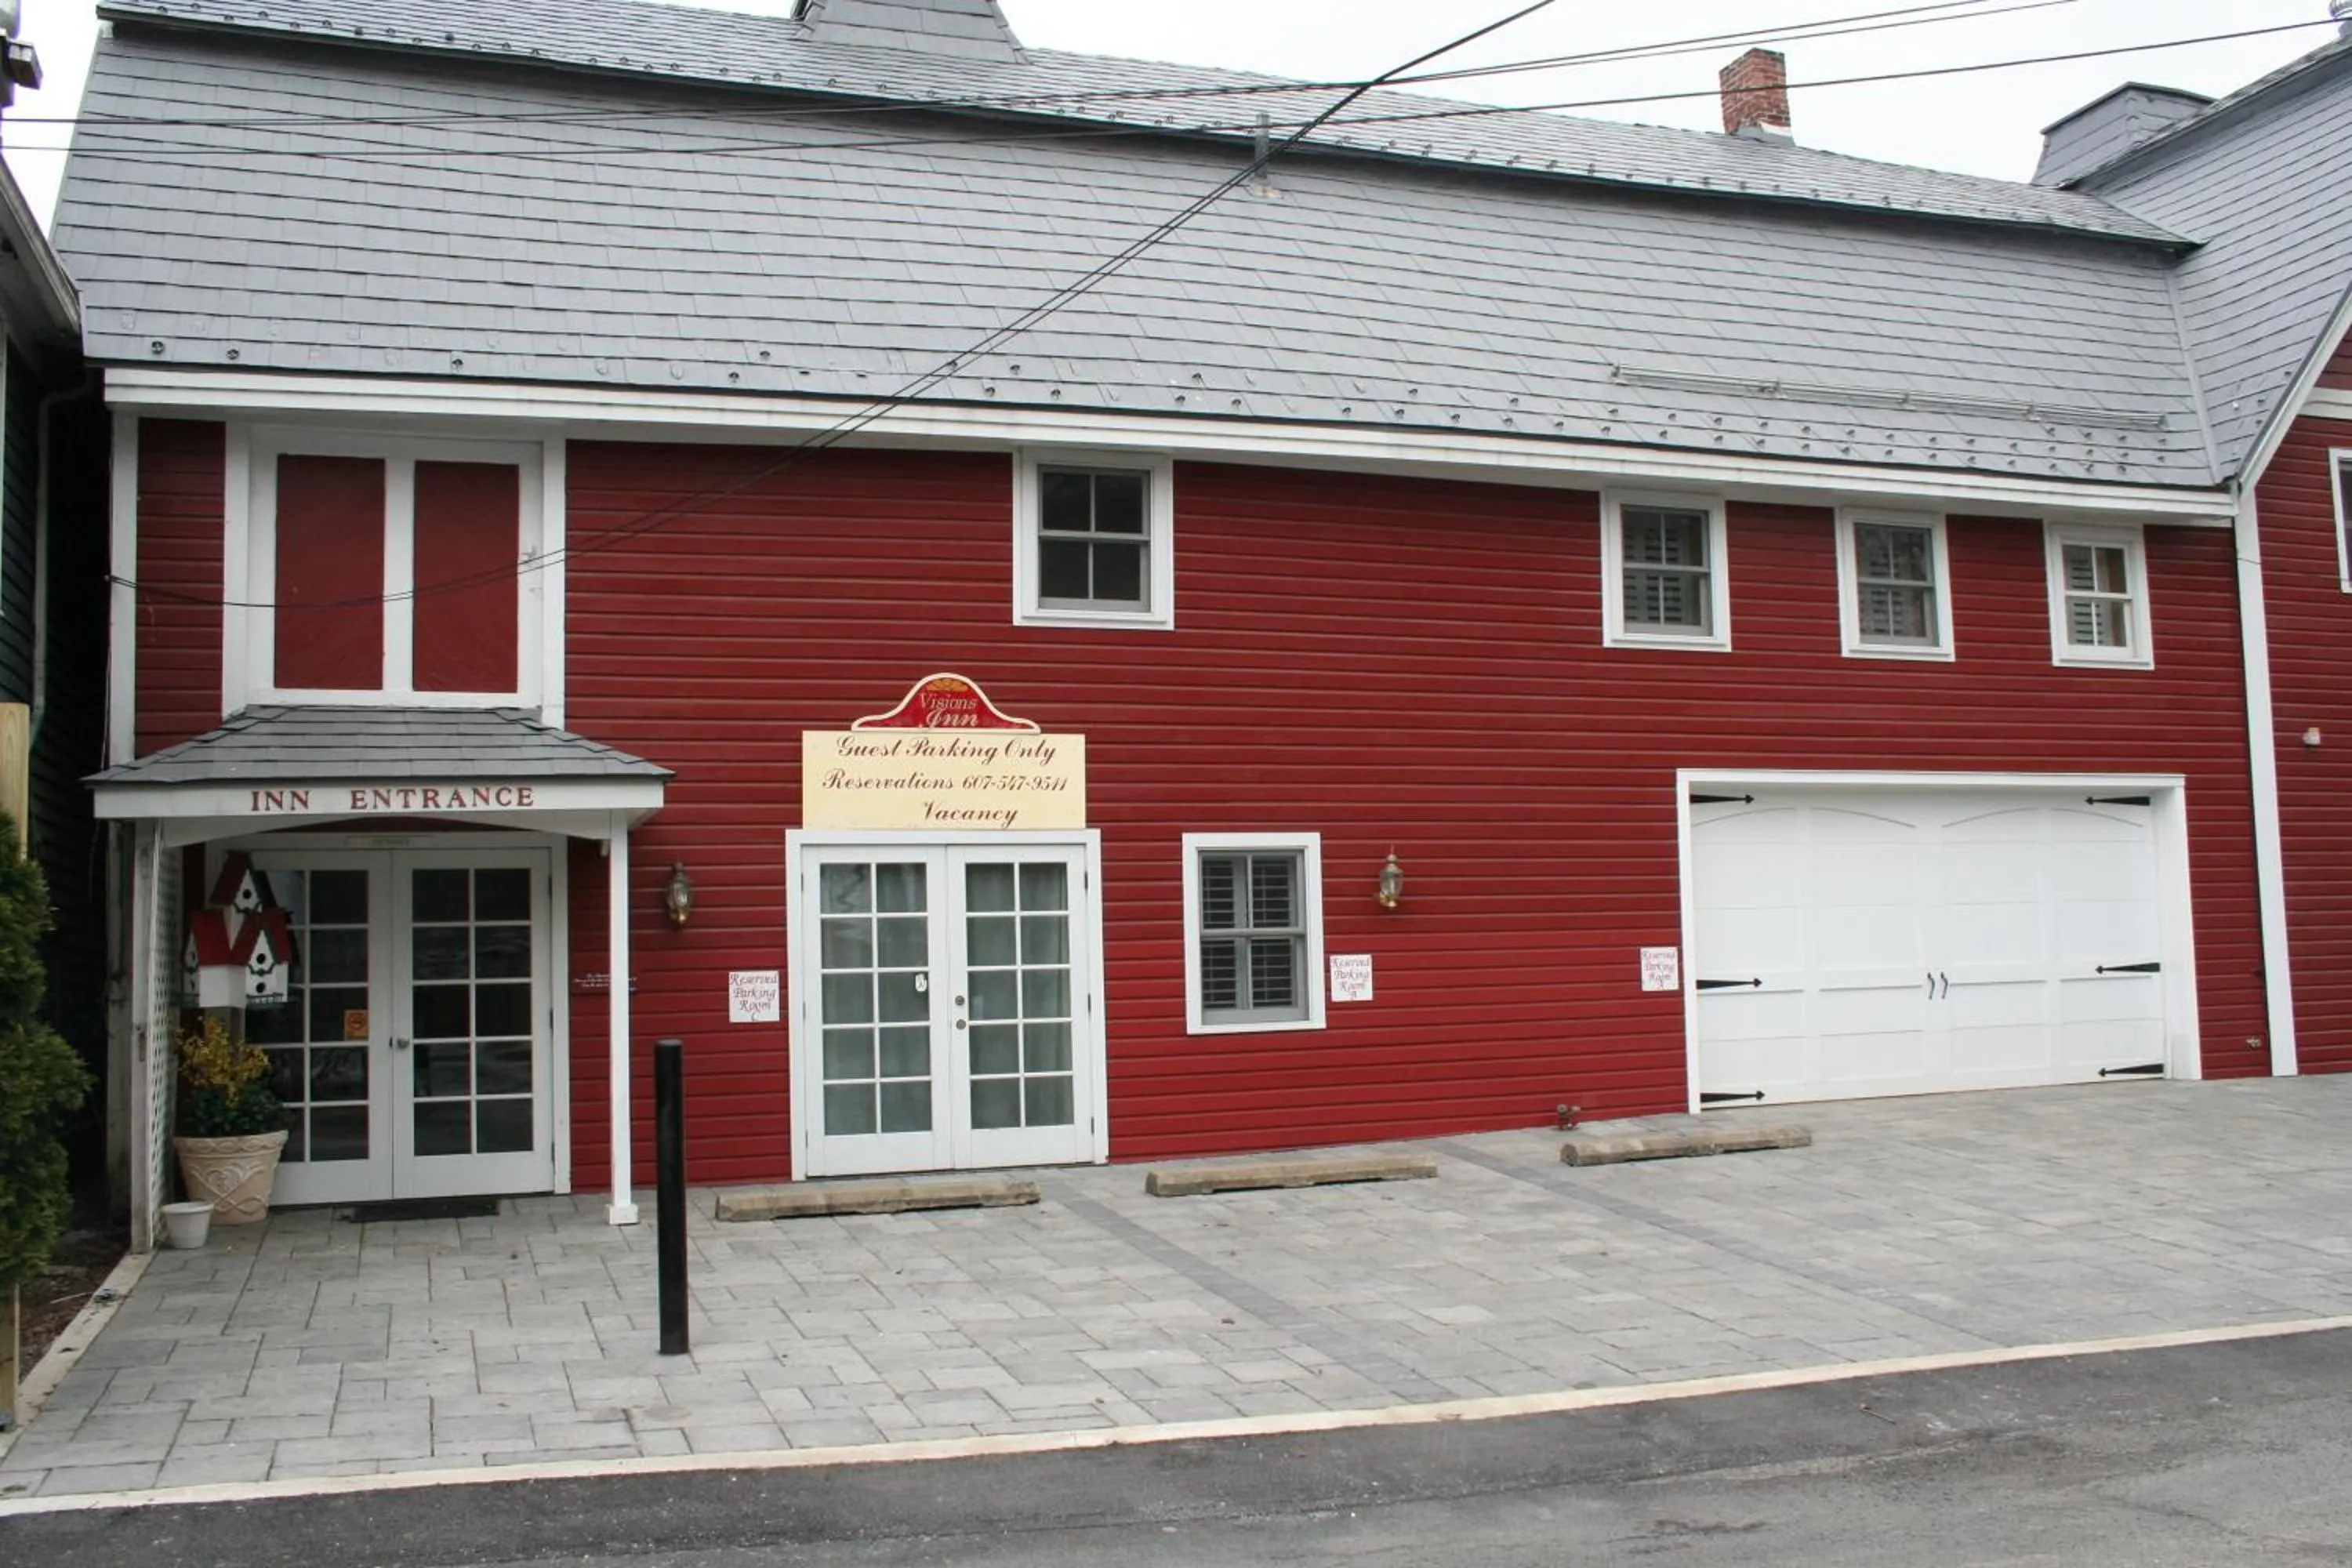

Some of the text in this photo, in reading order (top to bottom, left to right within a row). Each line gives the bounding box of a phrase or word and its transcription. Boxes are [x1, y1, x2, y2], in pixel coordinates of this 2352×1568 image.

[920, 693, 978, 710] Visions
[926, 708, 978, 728] Inn
[837, 735, 1056, 766] Guest Parking Only
[822, 768, 954, 789] Reservations
[251, 786, 535, 811] INN ENTRANCE
[924, 800, 1018, 829] Vacancy
[730, 974, 777, 985] Reserved
[733, 987, 777, 1001] Parking
[739, 1000, 771, 1013] Room
